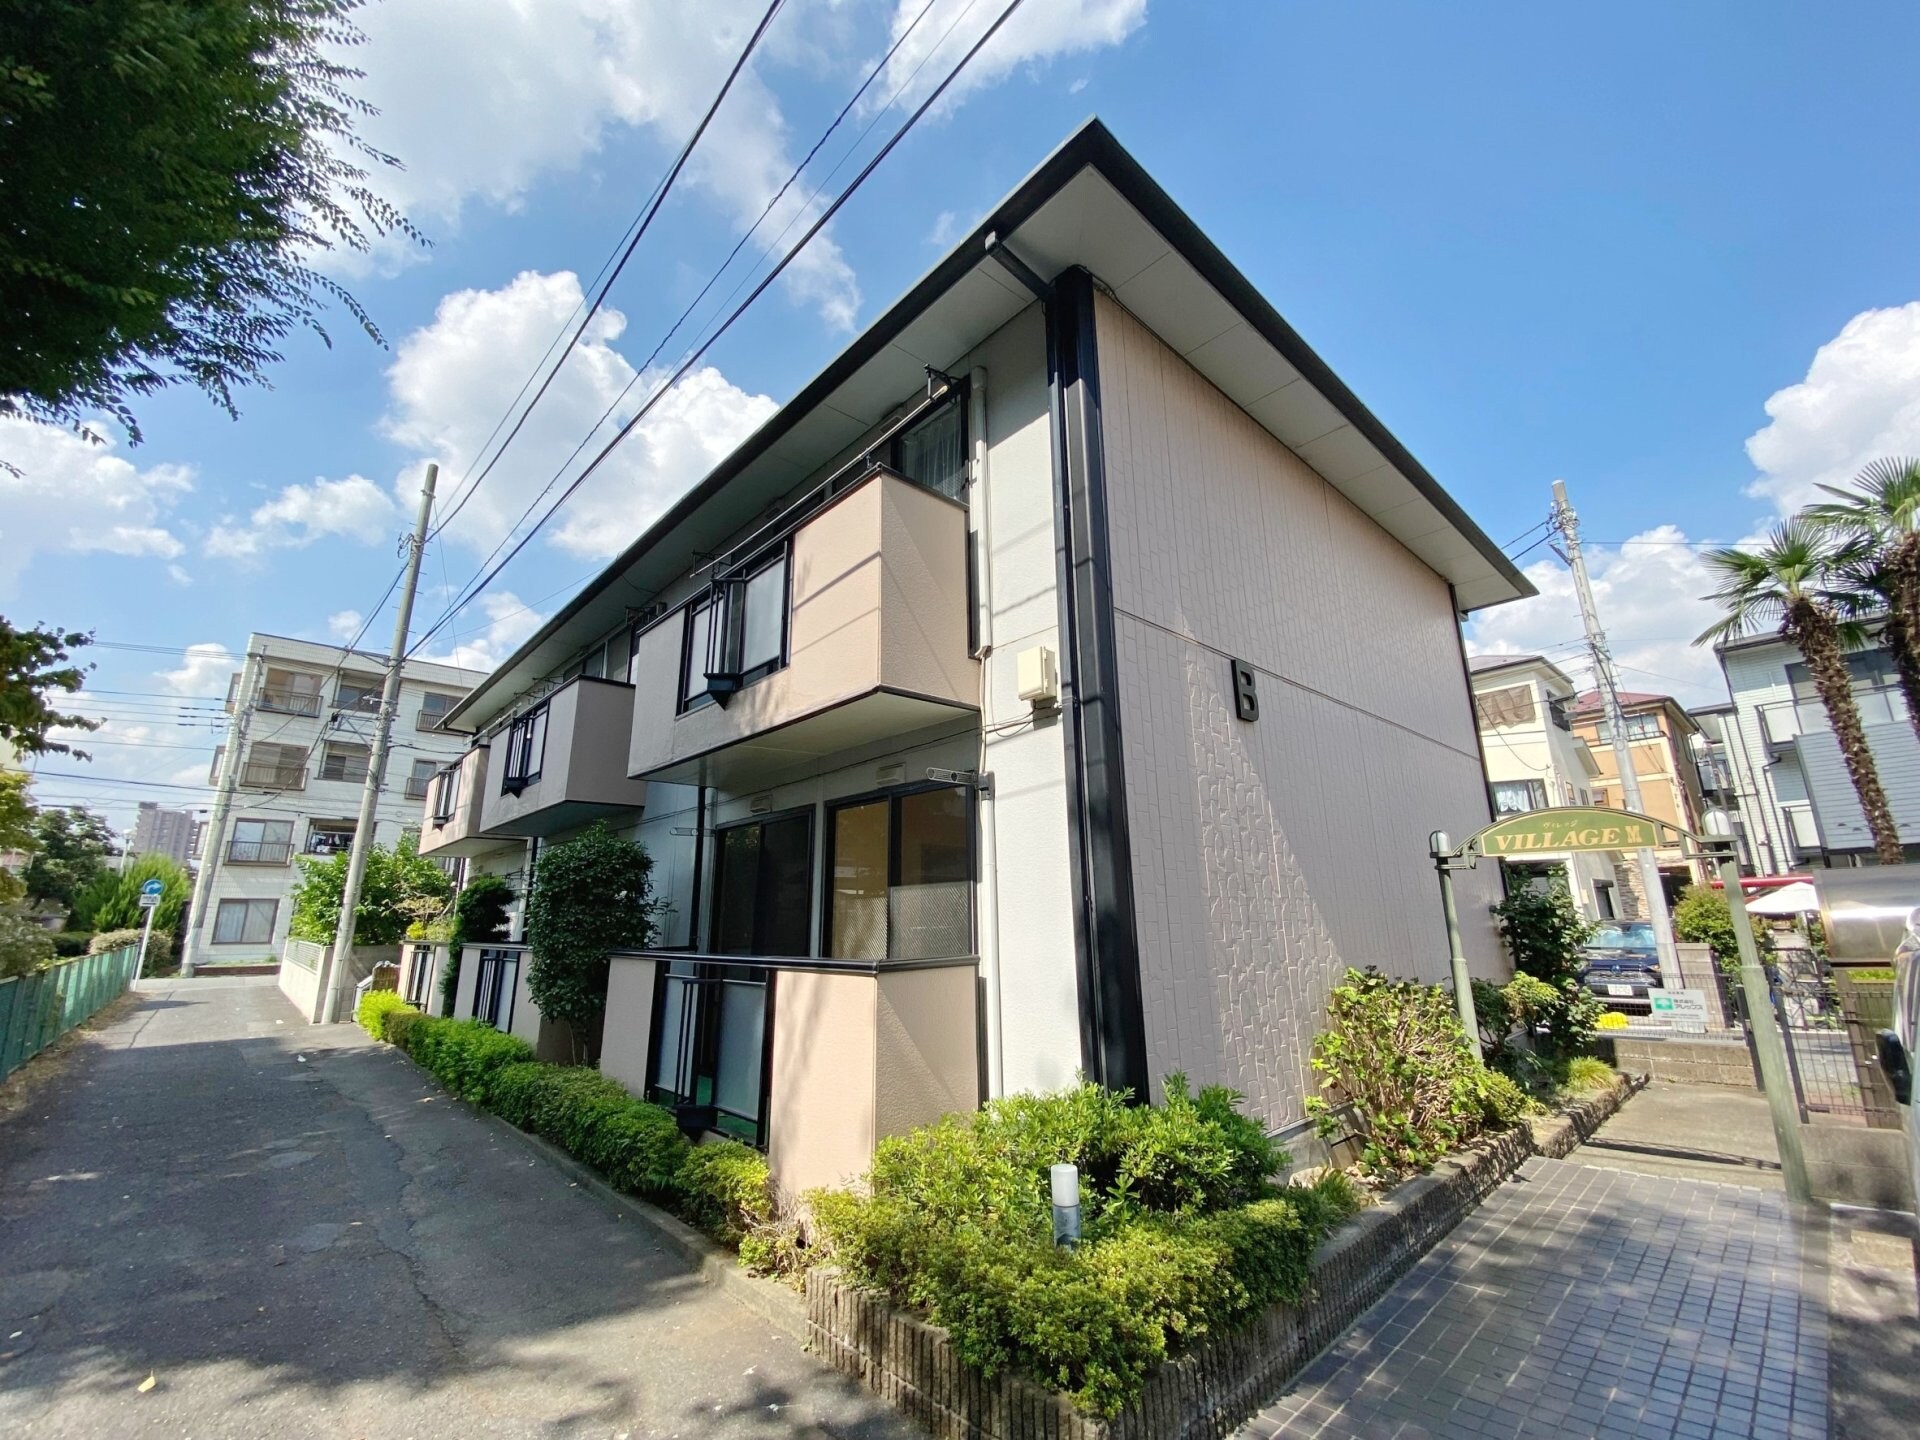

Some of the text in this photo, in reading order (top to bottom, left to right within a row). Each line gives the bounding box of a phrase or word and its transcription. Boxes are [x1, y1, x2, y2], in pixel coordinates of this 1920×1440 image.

[1230, 659, 1260, 722] B
[1494, 825, 1643, 850] VILLAGE M
